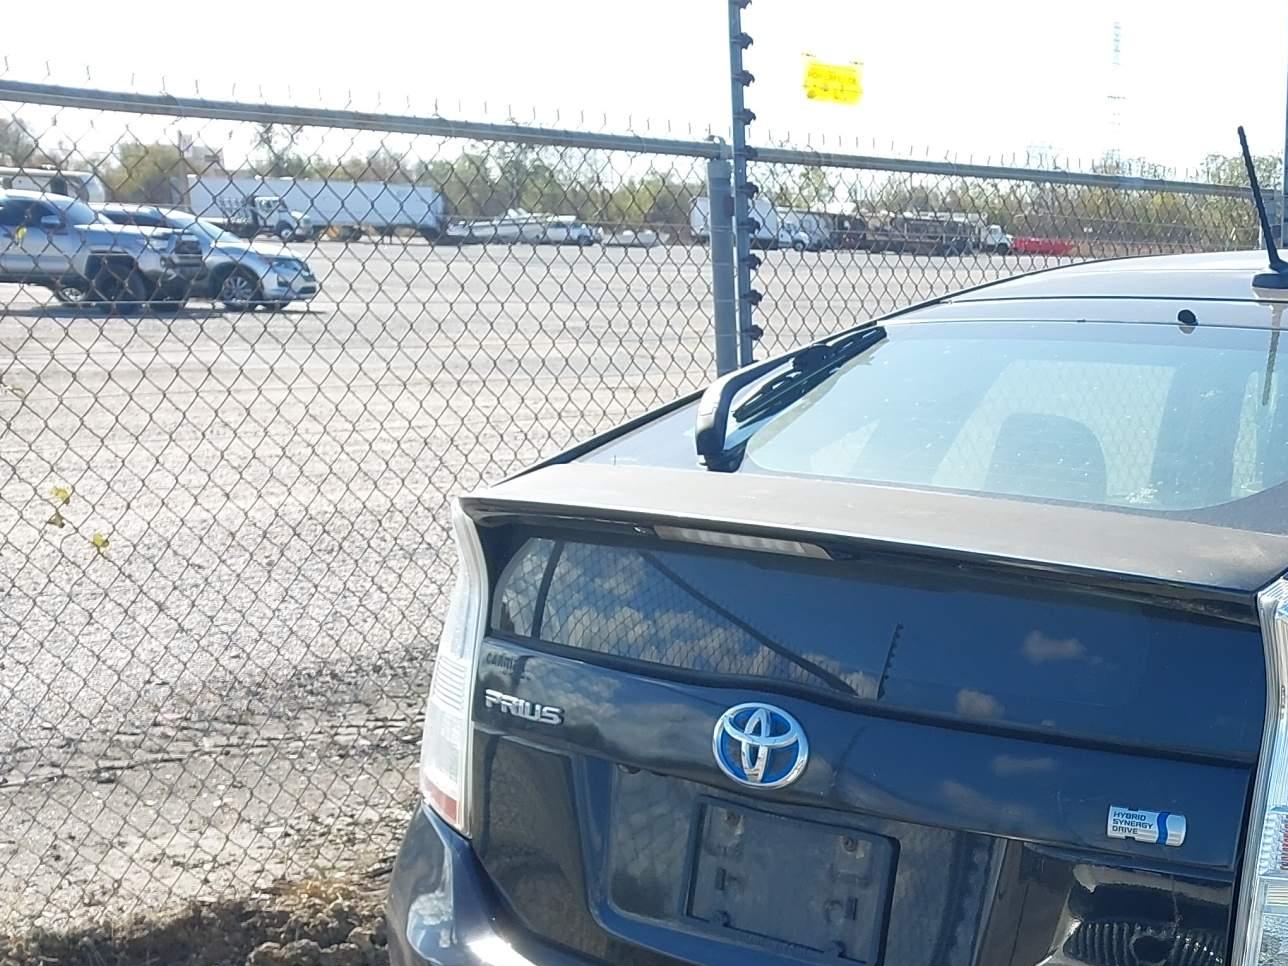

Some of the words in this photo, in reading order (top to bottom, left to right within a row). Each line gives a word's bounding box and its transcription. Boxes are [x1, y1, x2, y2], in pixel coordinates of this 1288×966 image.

[484, 688, 565, 725] PRIUS
[1113, 811, 1147, 822] HYBRID
[1112, 818, 1153, 830] SYNERGY
[1112, 826, 1139, 835] DRIVE
